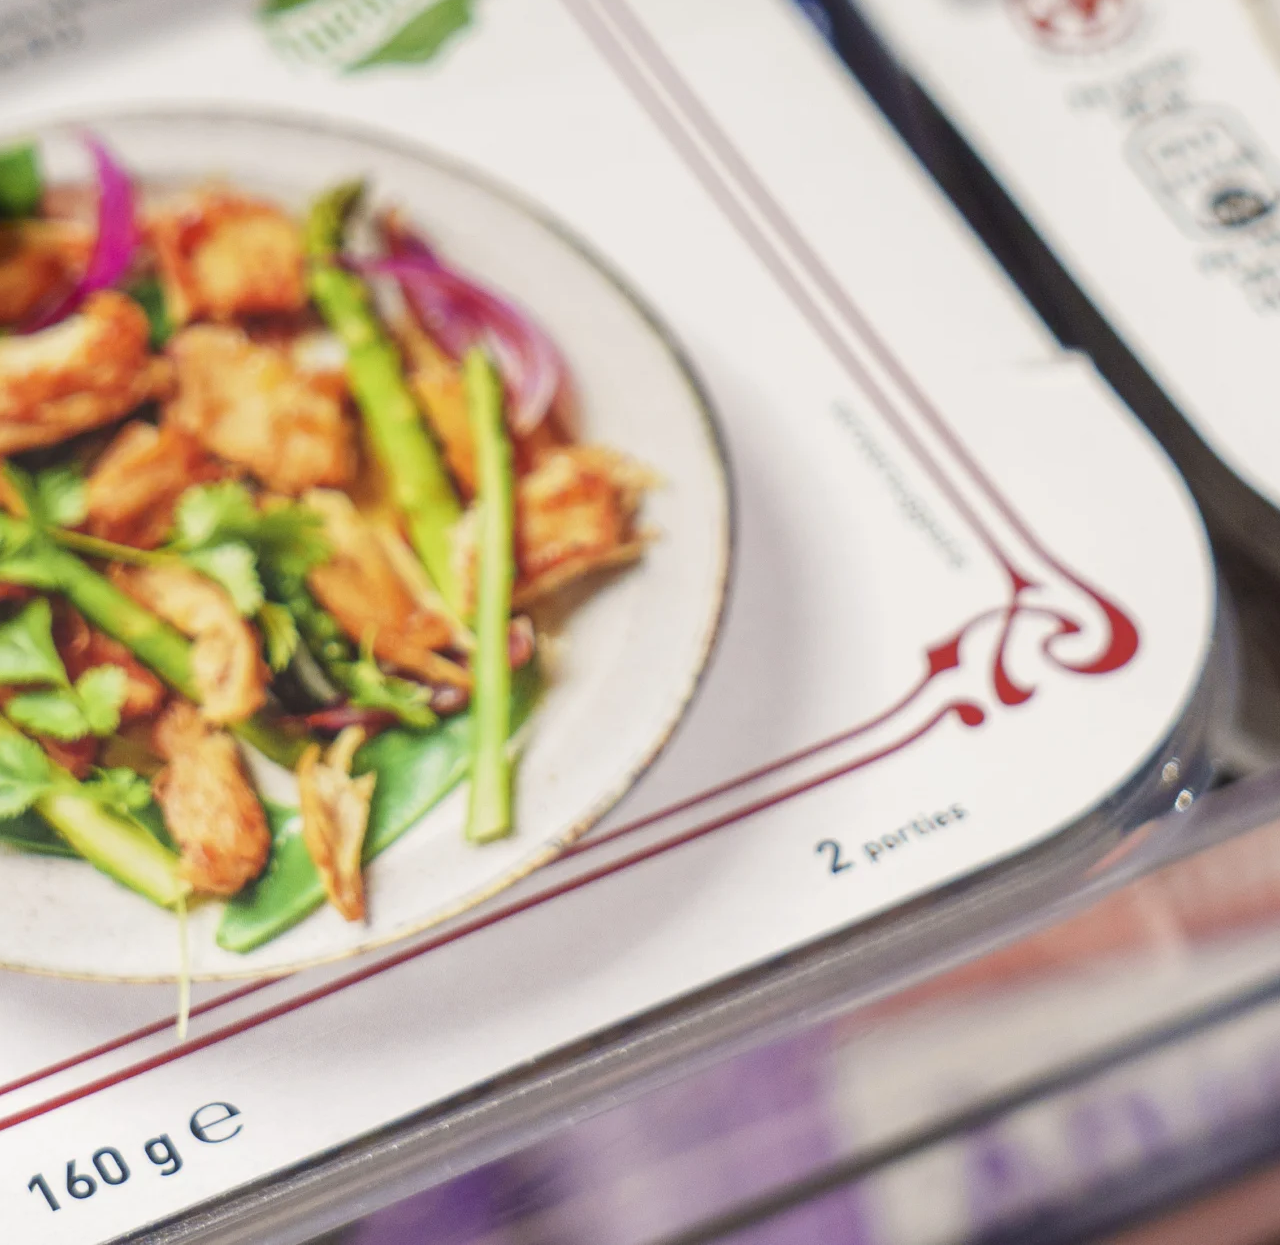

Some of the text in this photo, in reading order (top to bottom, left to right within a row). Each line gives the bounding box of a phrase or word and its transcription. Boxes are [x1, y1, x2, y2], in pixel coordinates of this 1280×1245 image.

[815, 804, 968, 874] 2 porties
[27, 1146, 131, 1212] 160
[143, 1133, 184, 1177] g
